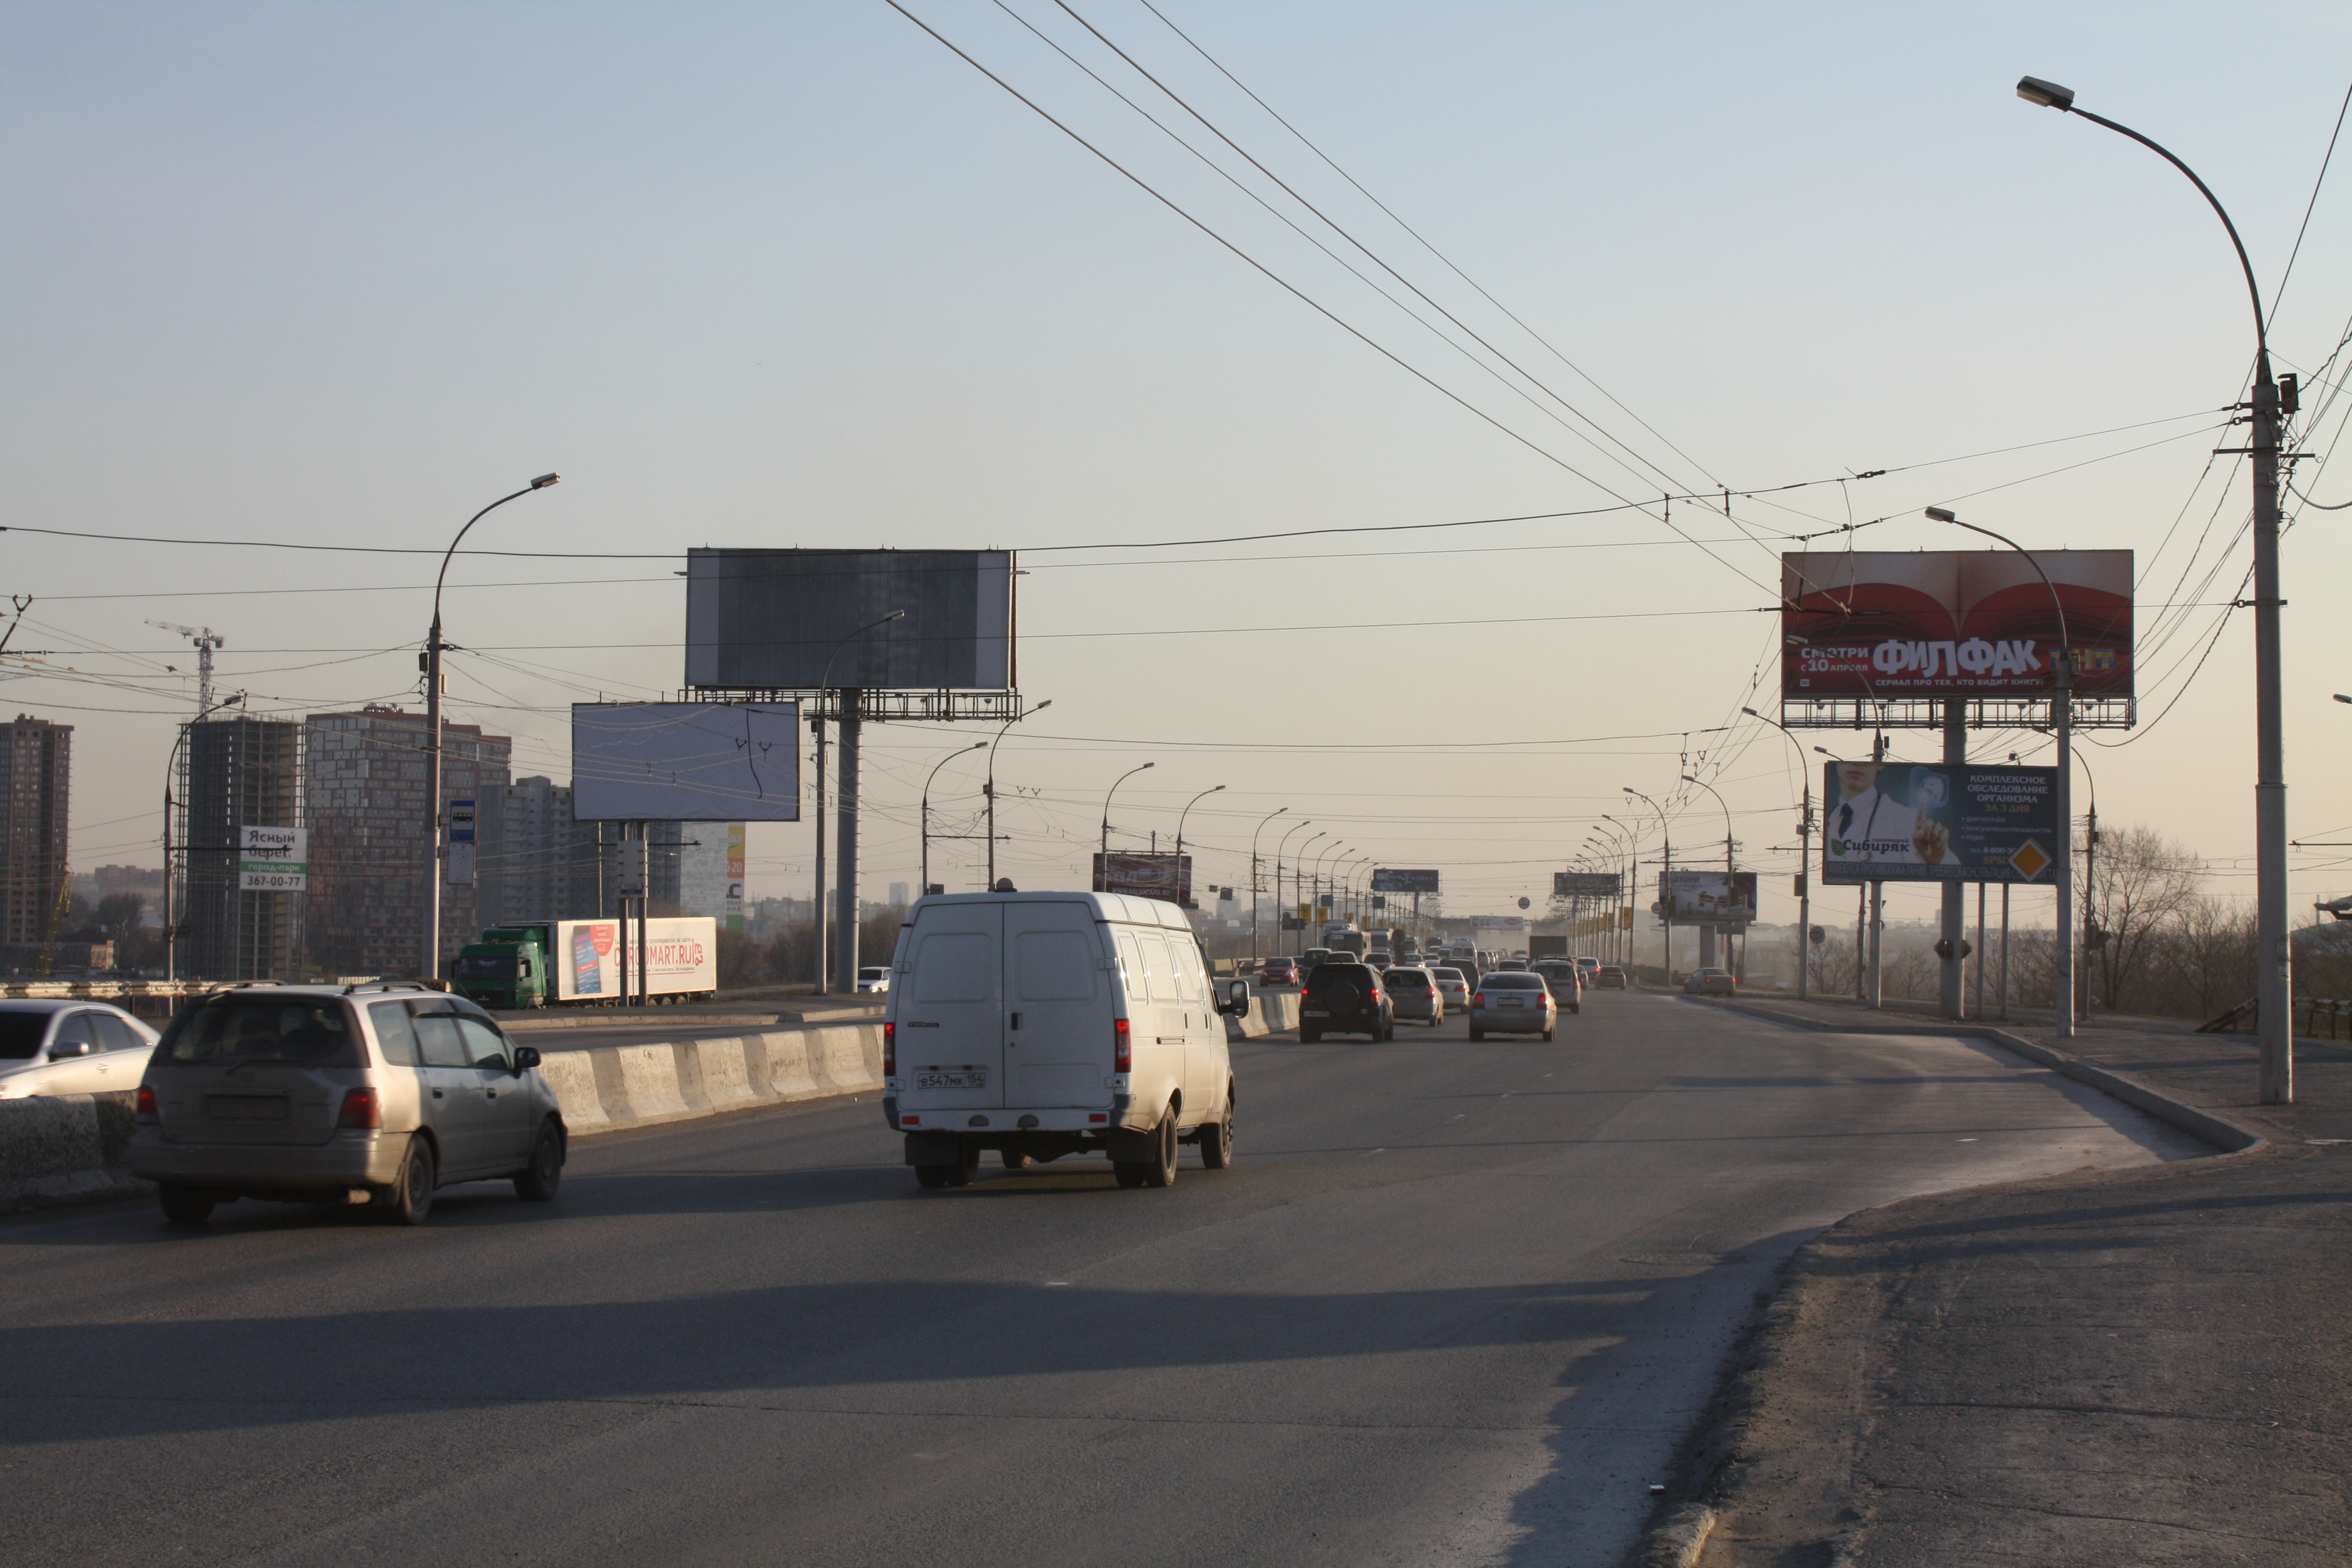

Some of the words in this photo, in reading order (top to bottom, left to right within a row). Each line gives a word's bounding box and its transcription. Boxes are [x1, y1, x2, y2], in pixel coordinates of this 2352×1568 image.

[1801, 647, 1868, 658] СМОТРИ
[1873, 637, 2041, 678] ФИЛФАК
[1808, 658, 1829, 672] 10
[1935, 679, 1954, 687] ТЕХ,
[1970, 775, 2046, 784] КОМПЛЕКСНОЕ
[1967, 784, 2049, 794] ОБСЛЕДОВАНИЕ
[1977, 794, 2038, 803] ОРГАНИЗМА
[249, 830, 295, 843] Ясный
[1843, 840, 1909, 854] Сибиряк
[248, 864, 301, 874] город-парк
[248, 875, 301, 886] 367-00-77
[921, 1075, 963, 1087] В547МК
[966, 1074, 984, 1083] 154
